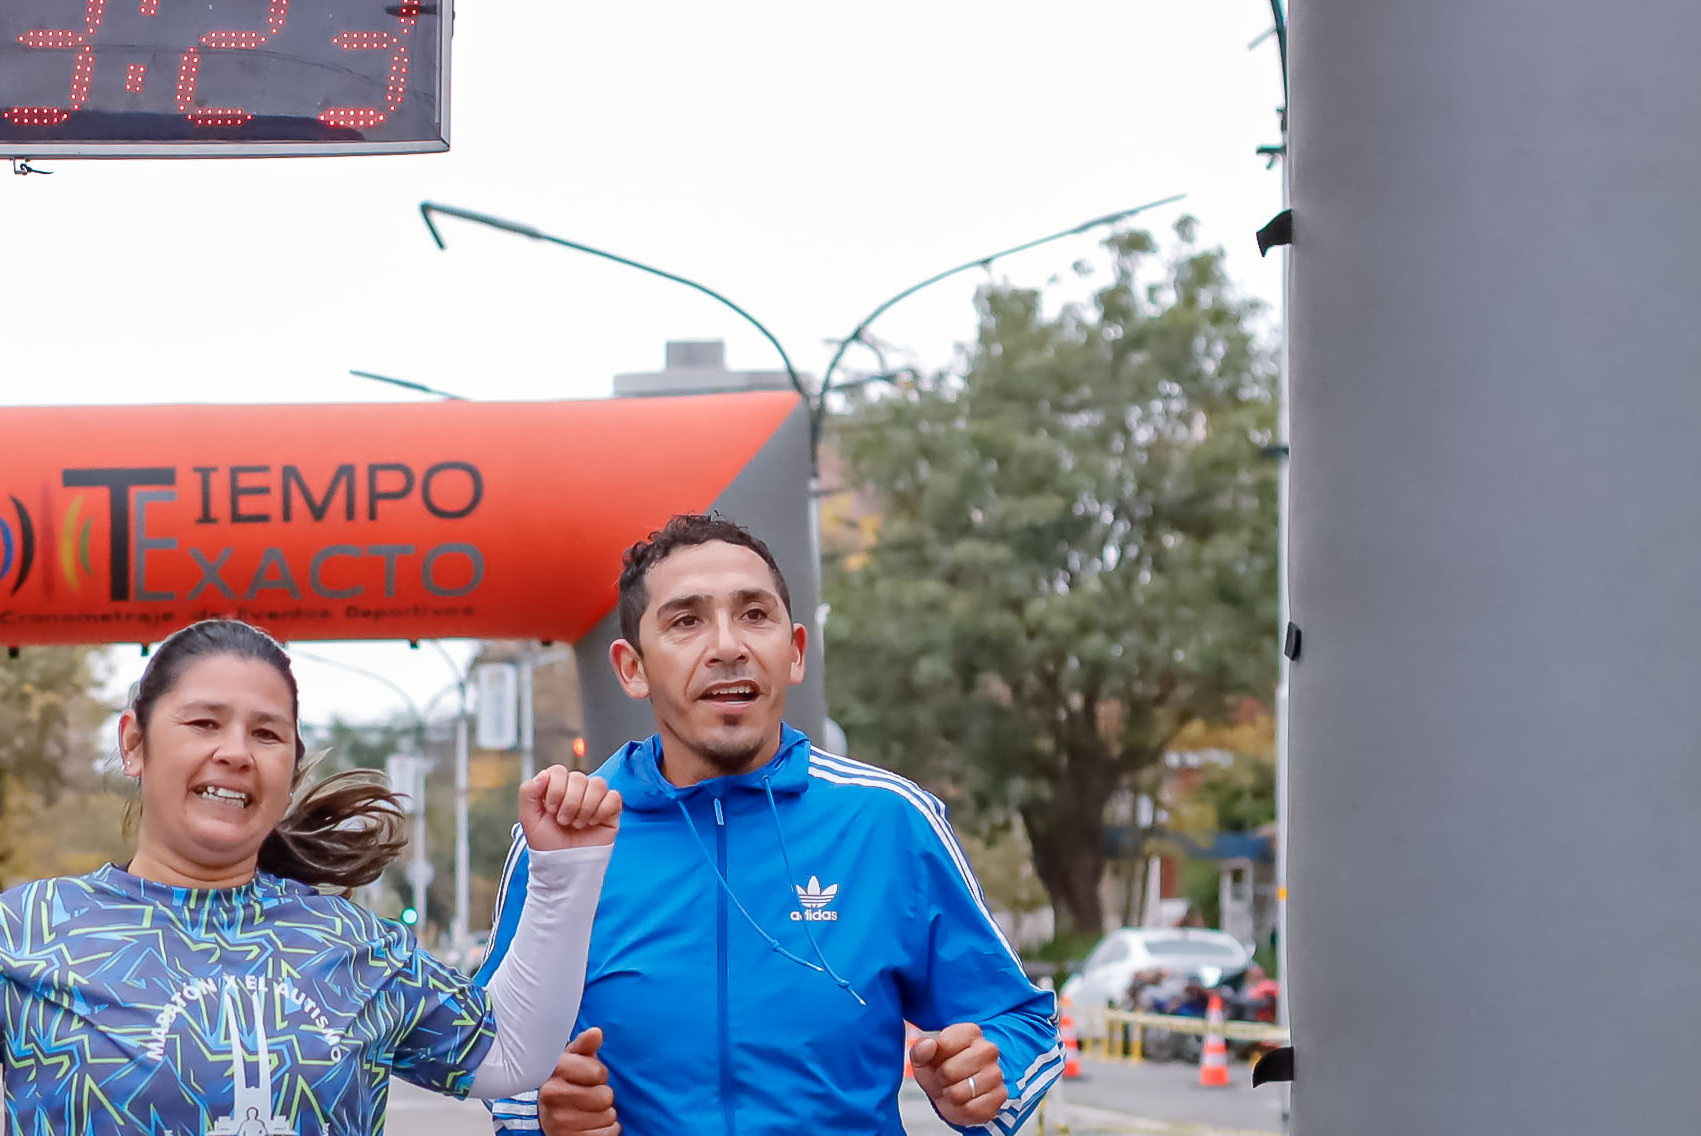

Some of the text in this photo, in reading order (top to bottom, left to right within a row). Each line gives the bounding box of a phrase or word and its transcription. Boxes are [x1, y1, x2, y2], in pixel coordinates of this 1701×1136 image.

[134, 490, 486, 602] EXACTO
[245, 974, 268, 991] EL
[278, 978, 341, 1063] AUTISMO
